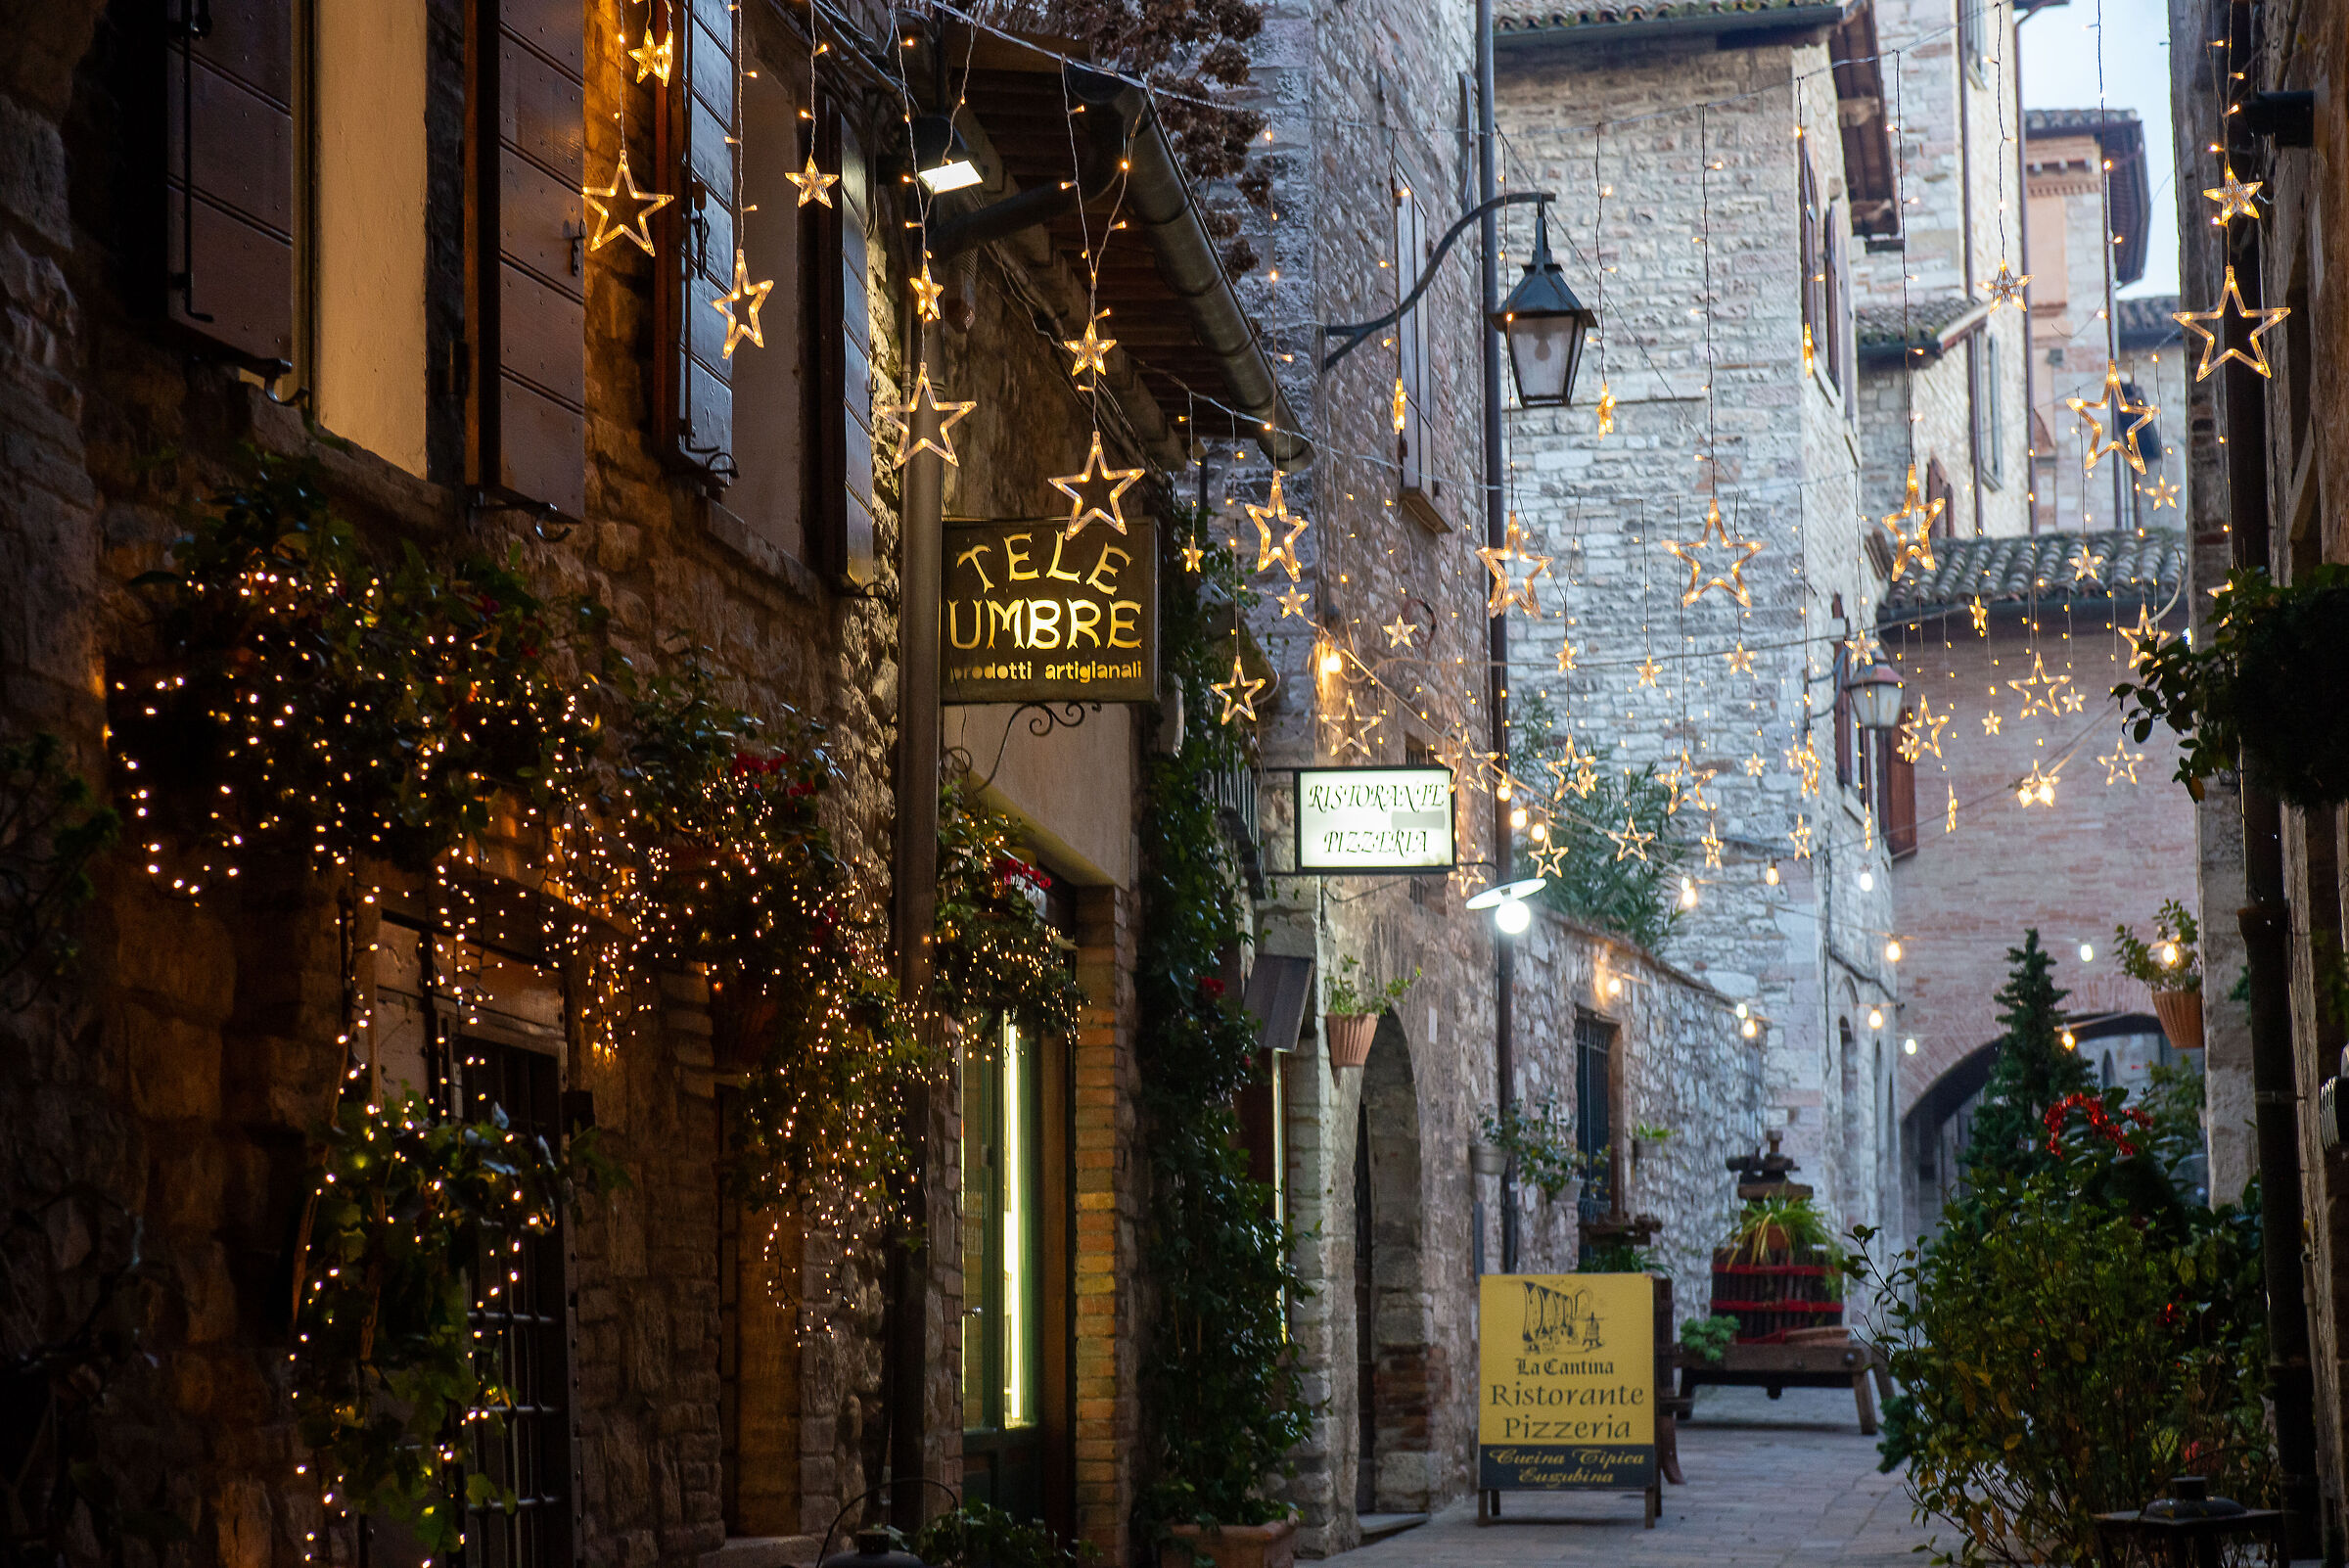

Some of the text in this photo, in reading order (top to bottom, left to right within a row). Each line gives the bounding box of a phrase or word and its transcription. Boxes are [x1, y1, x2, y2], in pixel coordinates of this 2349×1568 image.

[956, 530, 1133, 596] TELE
[947, 597, 1142, 650] UMBRE
[949, 660, 1142, 683] prodotti artigianali
[1309, 783, 1445, 813] RISTORANTE
[1323, 829, 1427, 857] PIZZERIA
[1515, 1358, 1614, 1376] La Cantina
[1490, 1381, 1644, 1407] Ristorante
[1503, 1414, 1632, 1440] Pizzeria
[1489, 1448, 1644, 1470] Cucina Tipica
[1518, 1467, 1614, 1489] Eugubina
